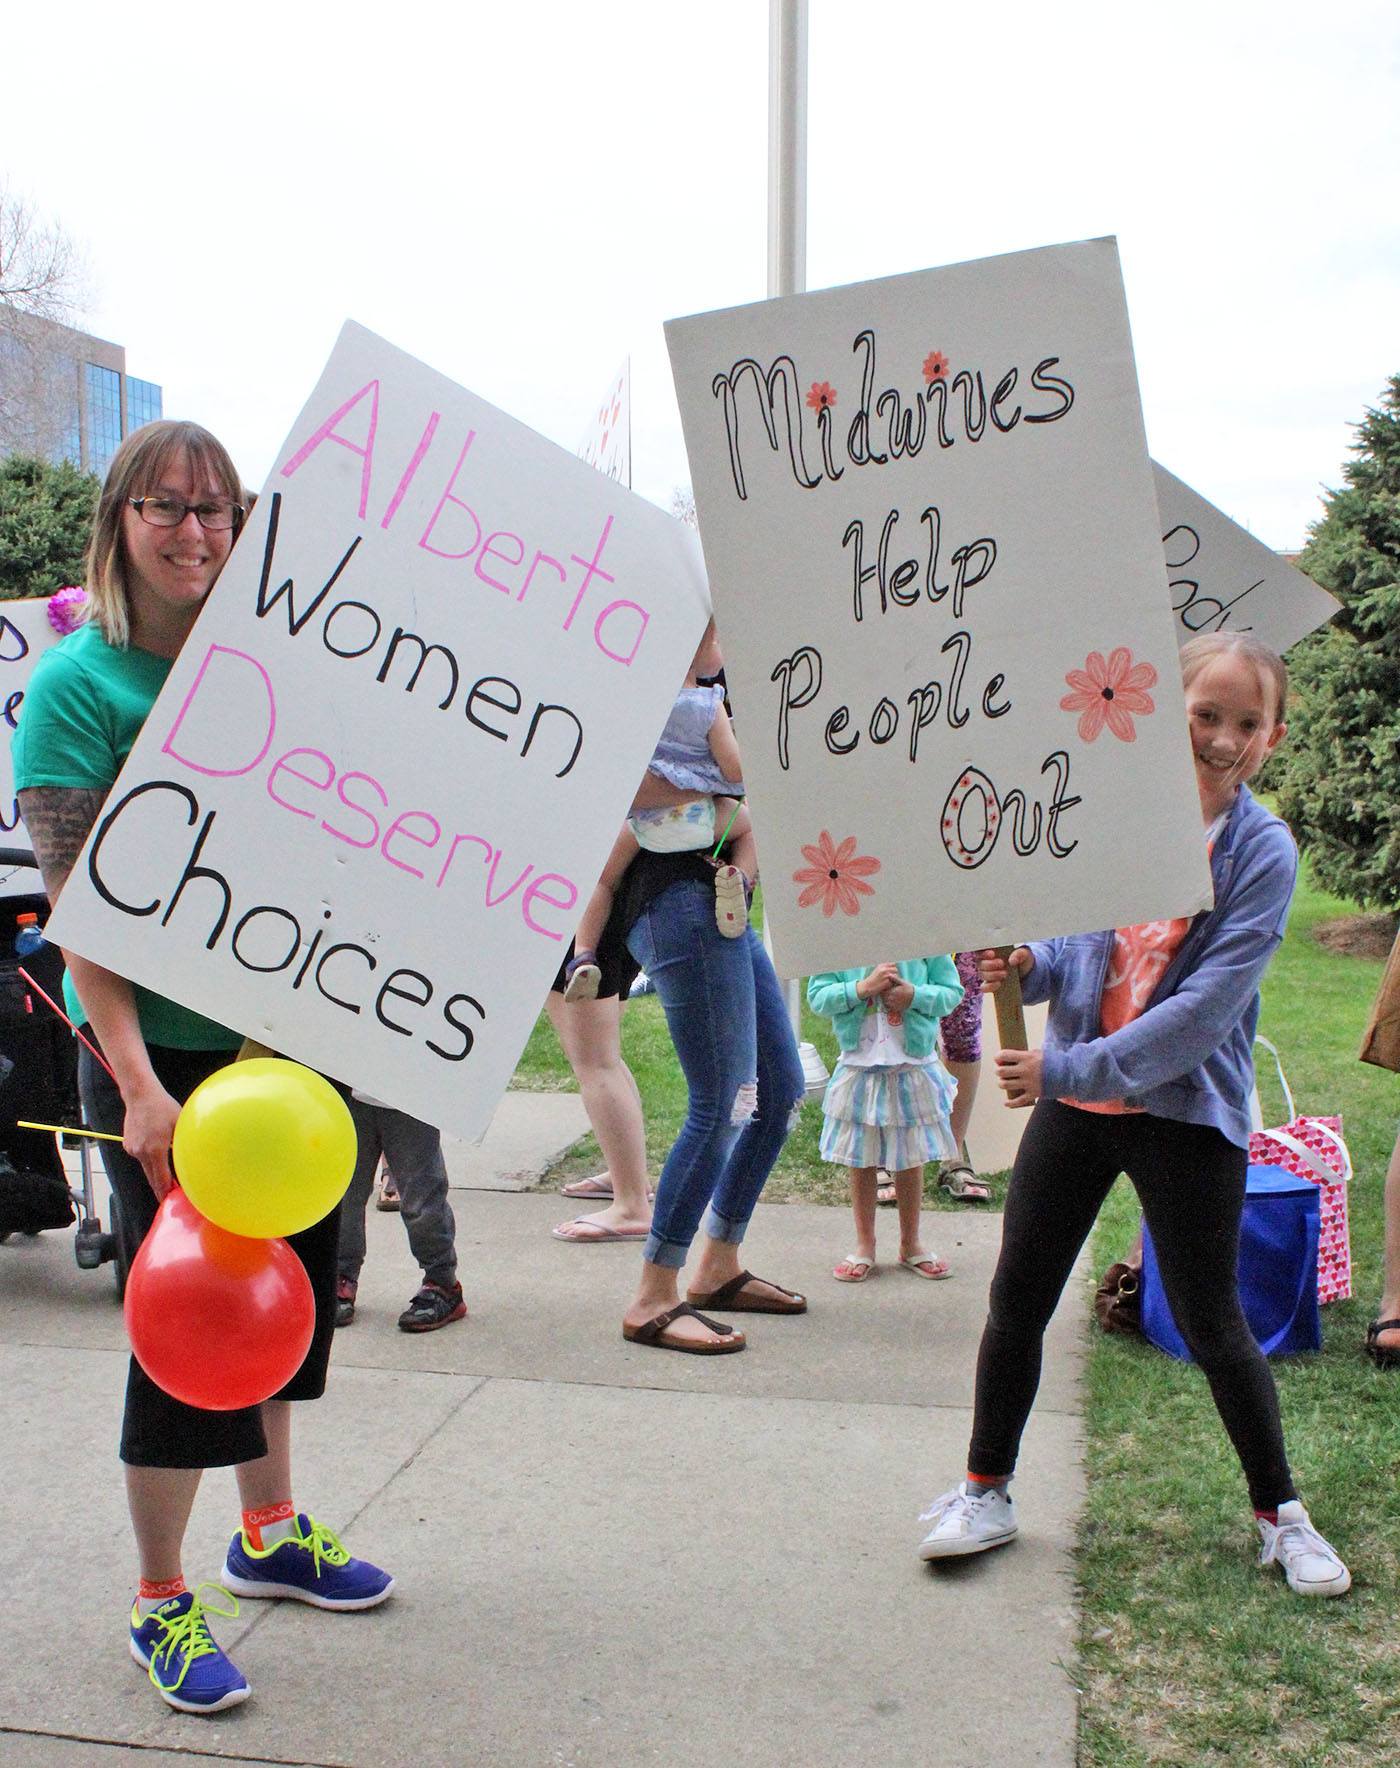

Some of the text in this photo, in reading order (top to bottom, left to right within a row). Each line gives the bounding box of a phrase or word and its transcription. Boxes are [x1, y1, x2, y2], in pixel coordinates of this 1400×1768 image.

[281, 379, 650, 666] Alberta
[711, 329, 1075, 501] Midwives
[256, 492, 583, 778] Women
[841, 506, 998, 623] Help
[161, 643, 579, 942] Deserve
[770, 630, 1012, 771] People
[939, 750, 1083, 871] Out
[89, 780, 486, 1062] Choices
